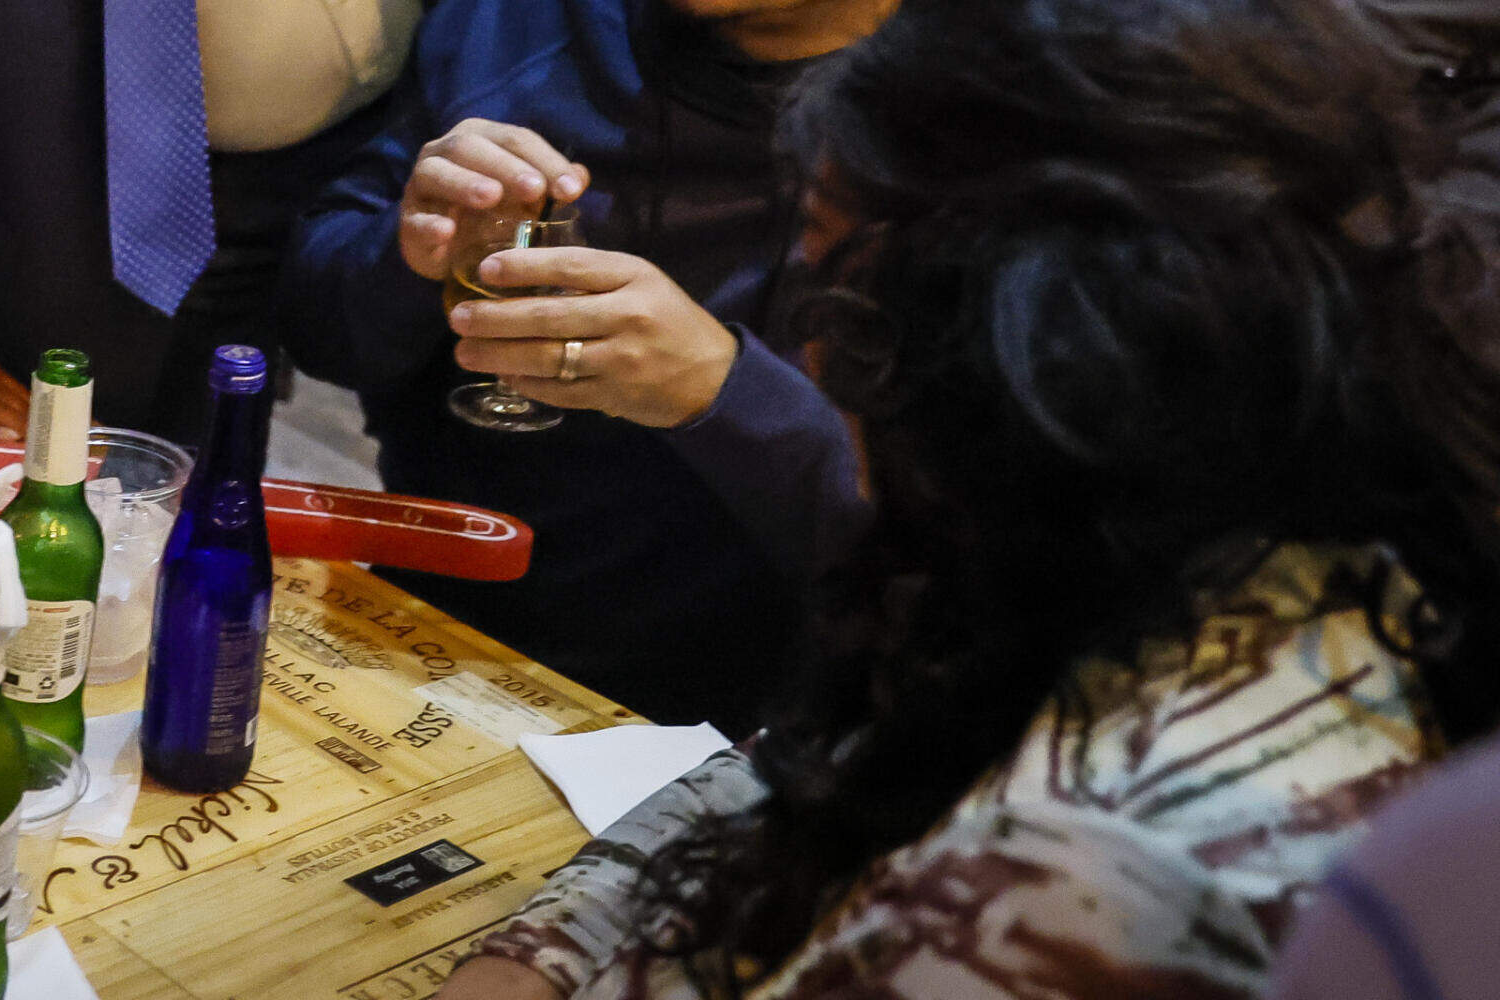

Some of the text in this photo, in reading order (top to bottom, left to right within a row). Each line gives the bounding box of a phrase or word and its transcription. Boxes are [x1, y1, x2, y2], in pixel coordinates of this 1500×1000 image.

[316, 587, 375, 614] DE
[367, 610, 418, 639] LA
[490, 673, 556, 708] 2015
[313, 705, 396, 752] LALANDE
[91, 769, 284, 889] Nickel &
[365, 839, 388, 854] OF
